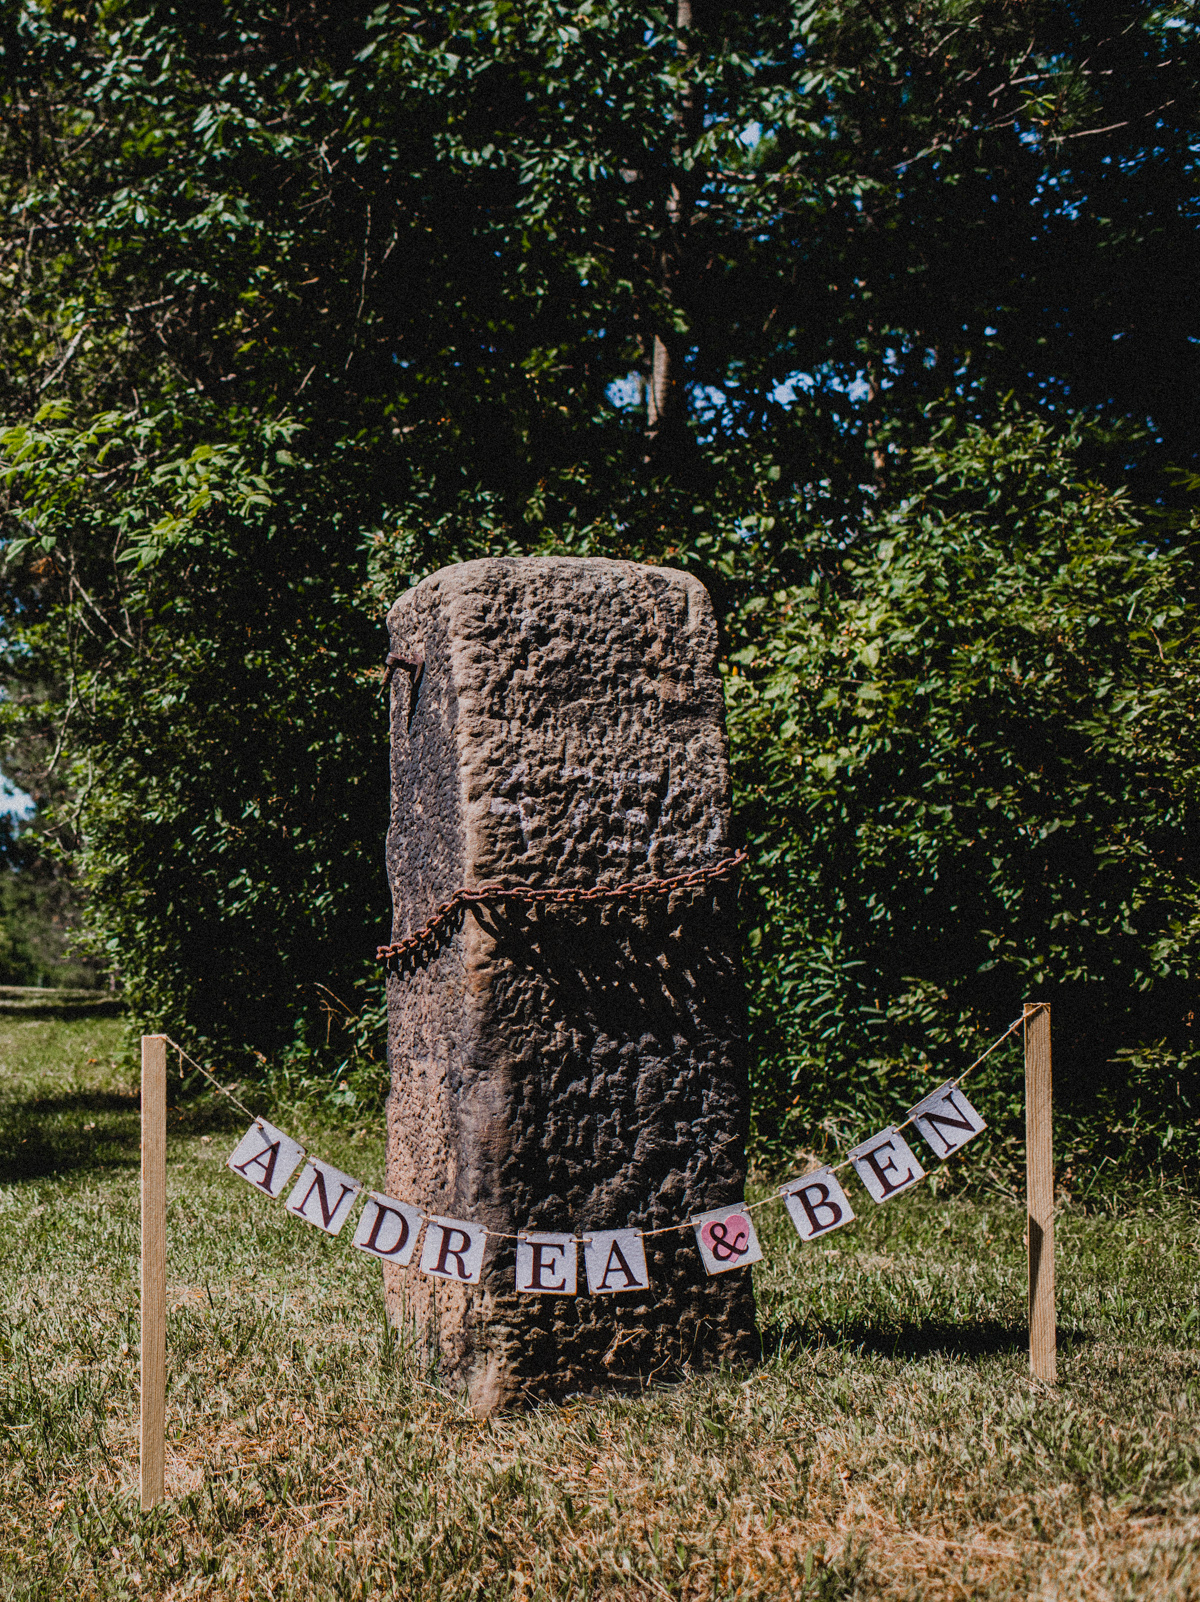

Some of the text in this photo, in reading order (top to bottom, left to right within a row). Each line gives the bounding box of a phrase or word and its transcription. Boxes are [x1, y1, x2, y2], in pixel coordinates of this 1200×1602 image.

[234, 1091, 976, 1290] ANDREA & BEN
